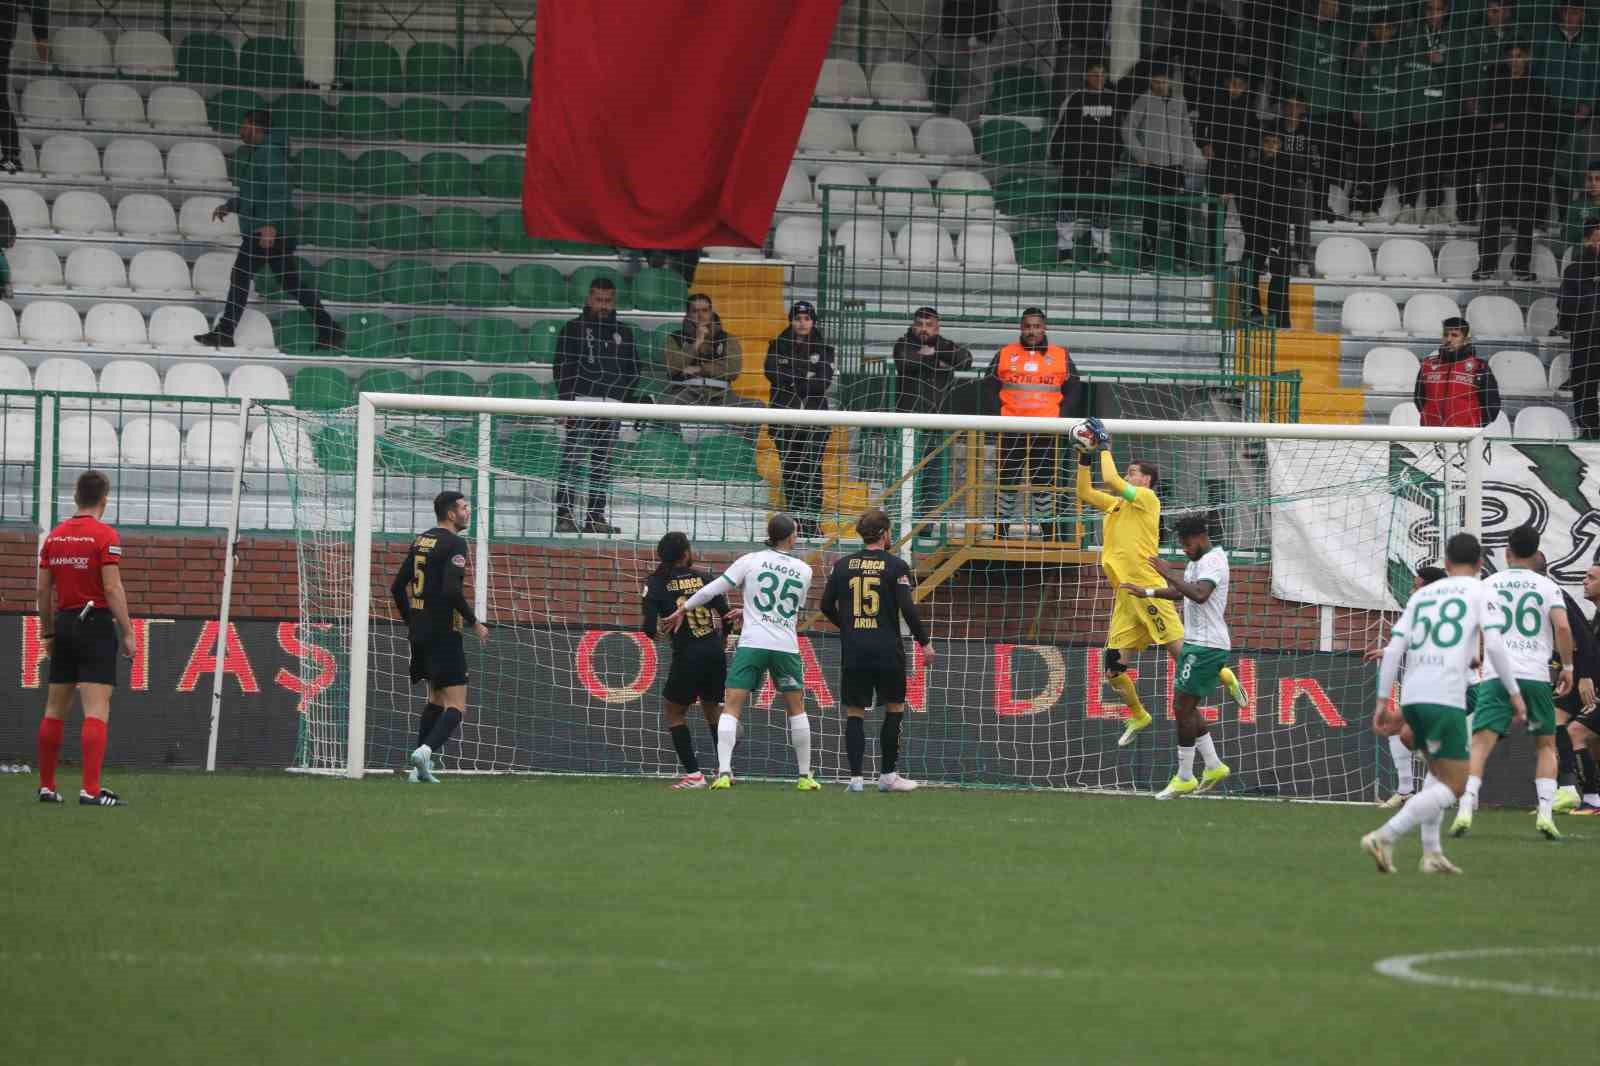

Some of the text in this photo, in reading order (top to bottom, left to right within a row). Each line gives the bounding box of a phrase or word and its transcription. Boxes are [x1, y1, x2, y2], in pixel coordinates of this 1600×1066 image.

[412, 554, 428, 597] 5
[753, 571, 804, 619] 35
[848, 575, 881, 617] 15
[853, 617, 879, 630] ARDA
[1408, 597, 1468, 651] 58
